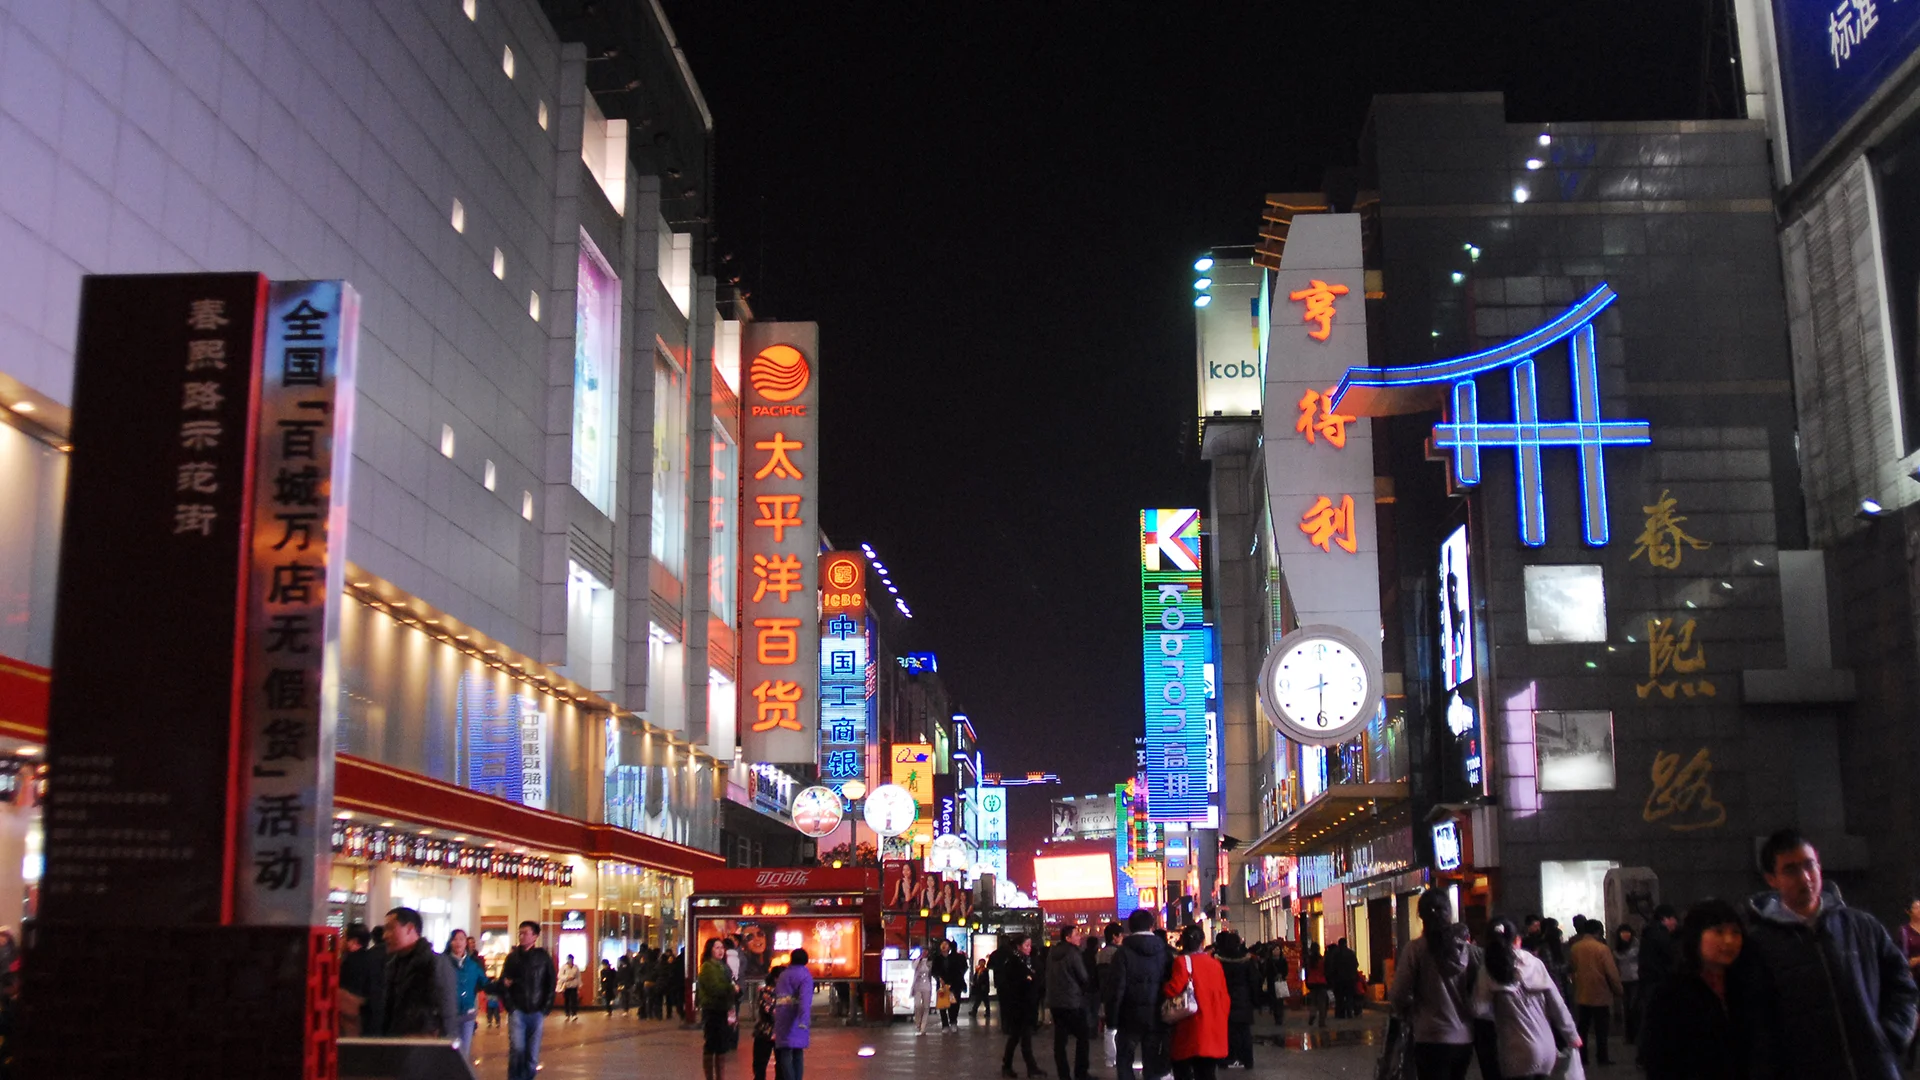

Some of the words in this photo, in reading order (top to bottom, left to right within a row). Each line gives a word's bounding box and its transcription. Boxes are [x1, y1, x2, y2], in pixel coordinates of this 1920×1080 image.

[1209, 360, 1260, 378] kob
[172, 298, 230, 536] 春熙路示范街
[752, 405, 807, 417] PACIFIC
[1289, 279, 1357, 554] 亨得利
[752, 432, 804, 732] 太平洋百货
[824, 593, 862, 607] ICBC
[1158, 584, 1190, 733] kobron
[756, 870, 812, 887] 可口可乐
